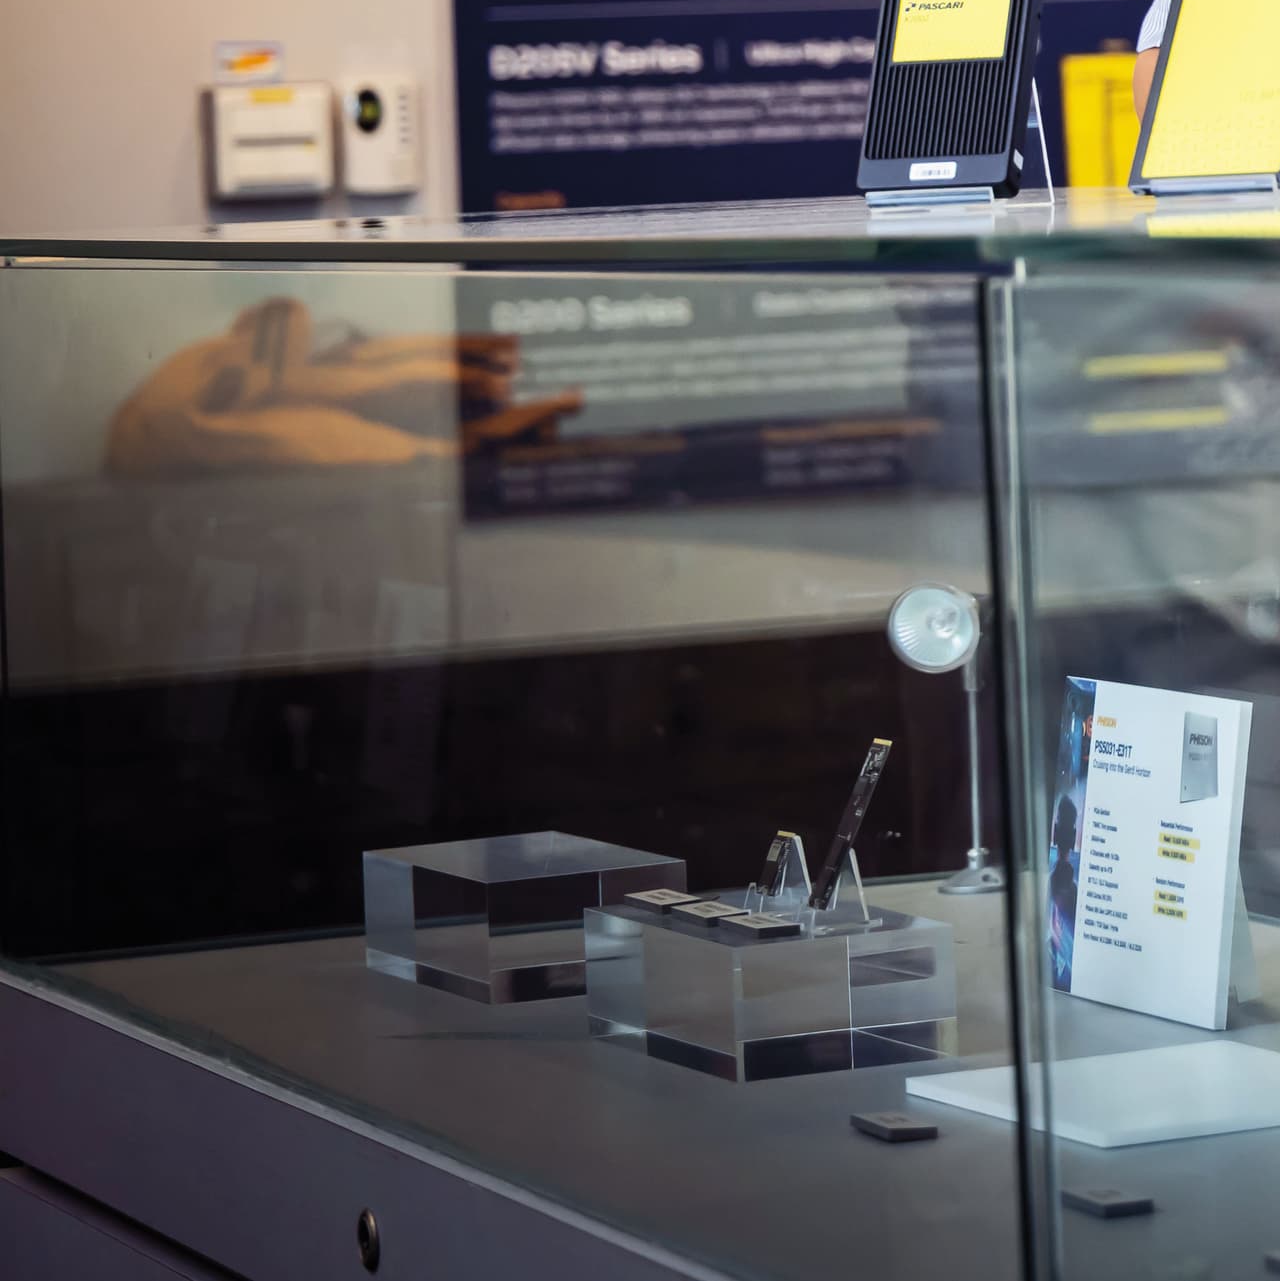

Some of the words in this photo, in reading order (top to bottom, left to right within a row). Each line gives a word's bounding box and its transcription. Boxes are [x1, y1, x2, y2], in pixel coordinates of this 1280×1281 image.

[918, 0, 965, 11] PASCARI
[602, 38, 705, 76] Series
[588, 293, 693, 330] Series
[1094, 739, 1133, 758] PS5031-E31T
[1188, 733, 1214, 747] PHISON
